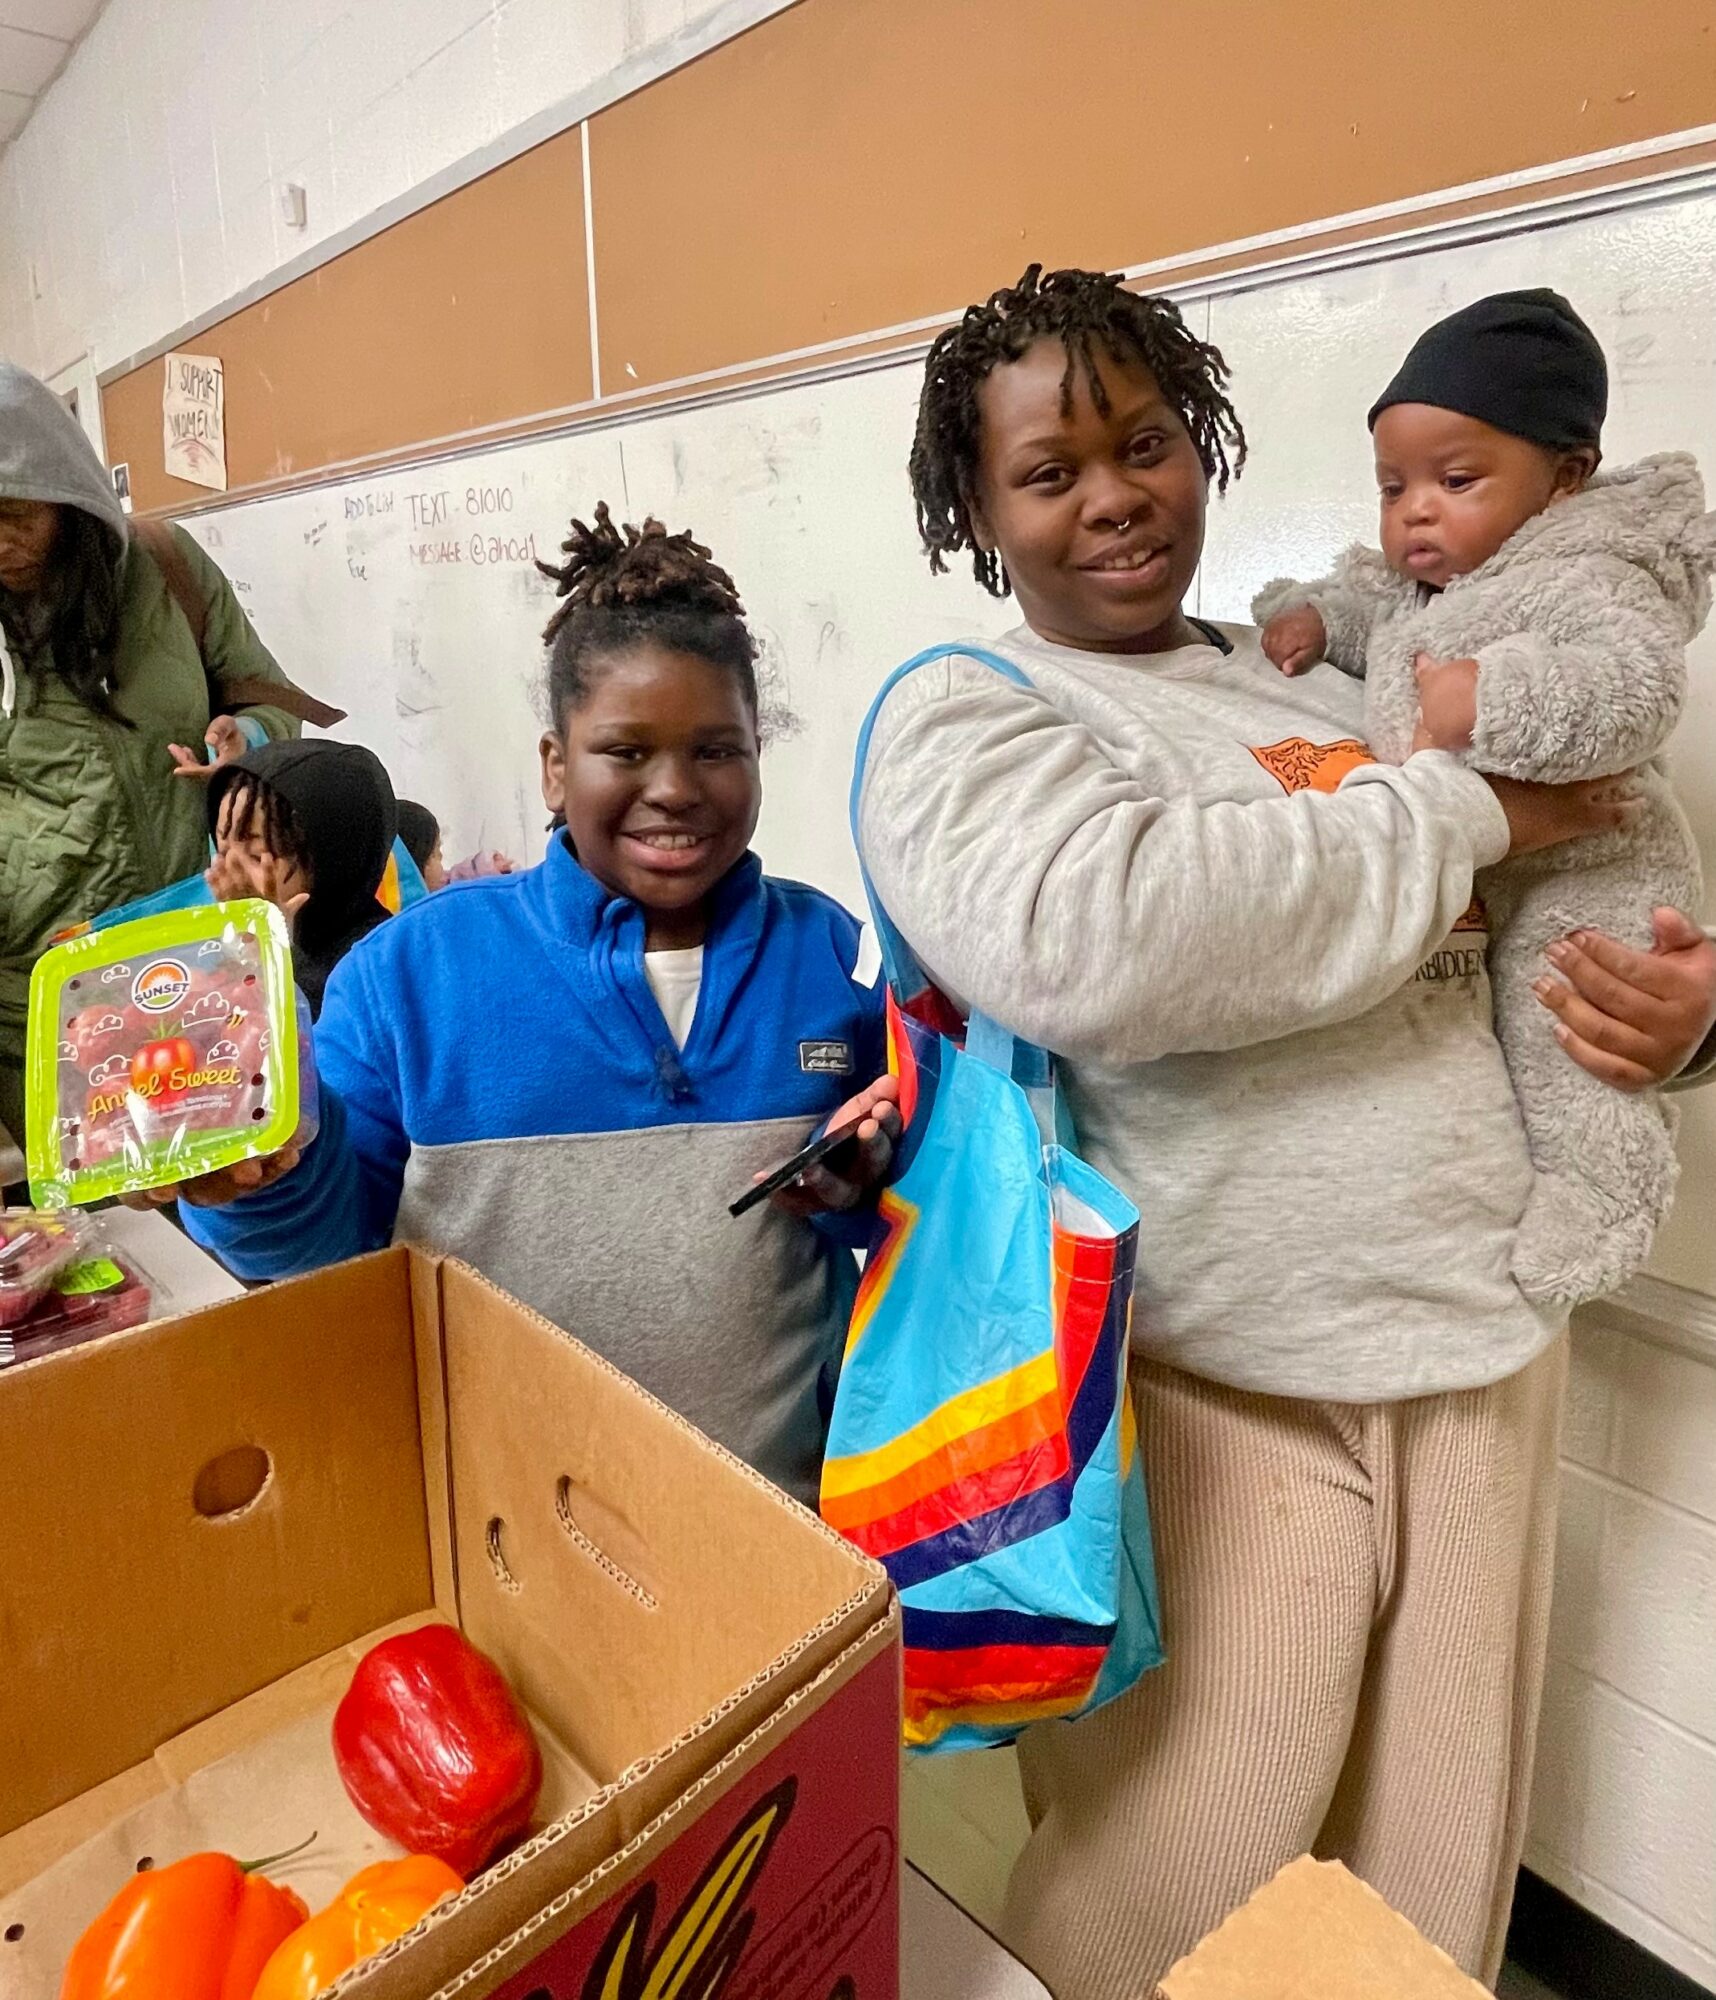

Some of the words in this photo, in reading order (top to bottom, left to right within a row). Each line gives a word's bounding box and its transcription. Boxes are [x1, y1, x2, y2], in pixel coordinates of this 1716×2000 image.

[167, 360, 172, 390] I
[465, 487, 513, 516] 81010
[134, 982, 190, 1005] SUNSET
[169, 1065, 242, 1091] Sweet
